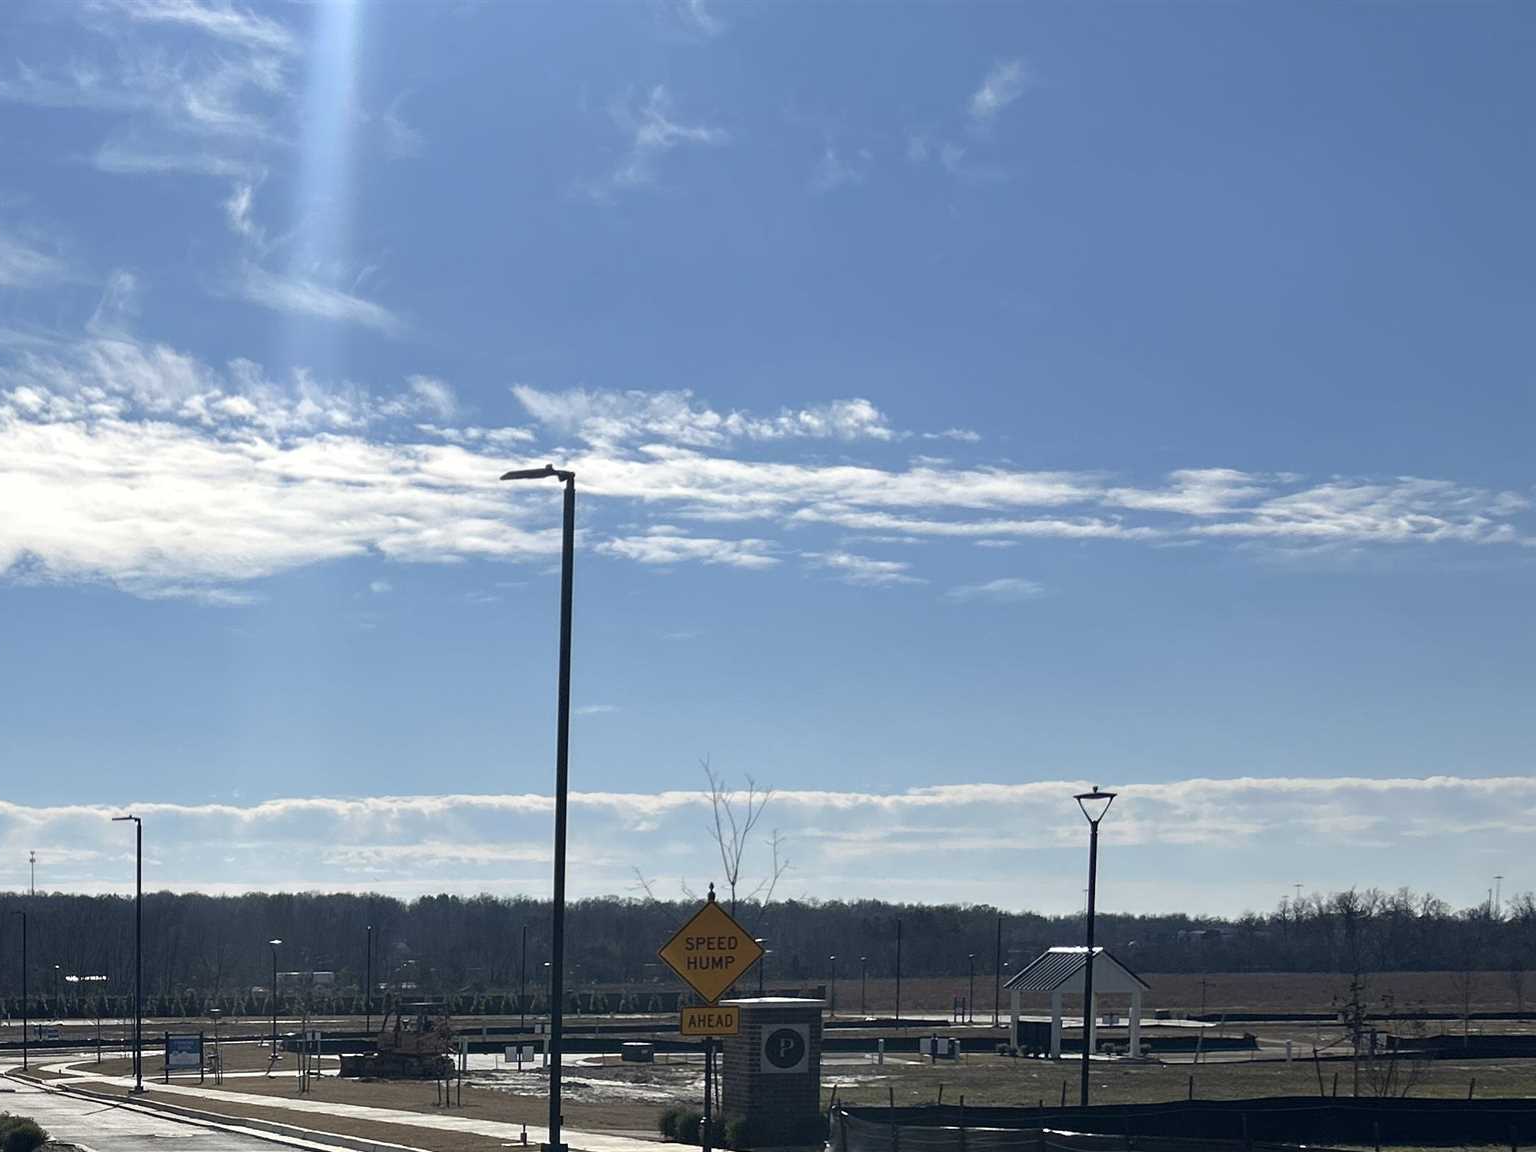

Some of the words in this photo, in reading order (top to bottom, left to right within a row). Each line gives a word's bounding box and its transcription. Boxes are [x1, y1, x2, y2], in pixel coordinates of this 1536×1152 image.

[685, 936, 738, 951] SPEED
[686, 955, 735, 970] HUMP
[688, 1014, 733, 1028] AHEAD
[779, 1037, 794, 1058] P
